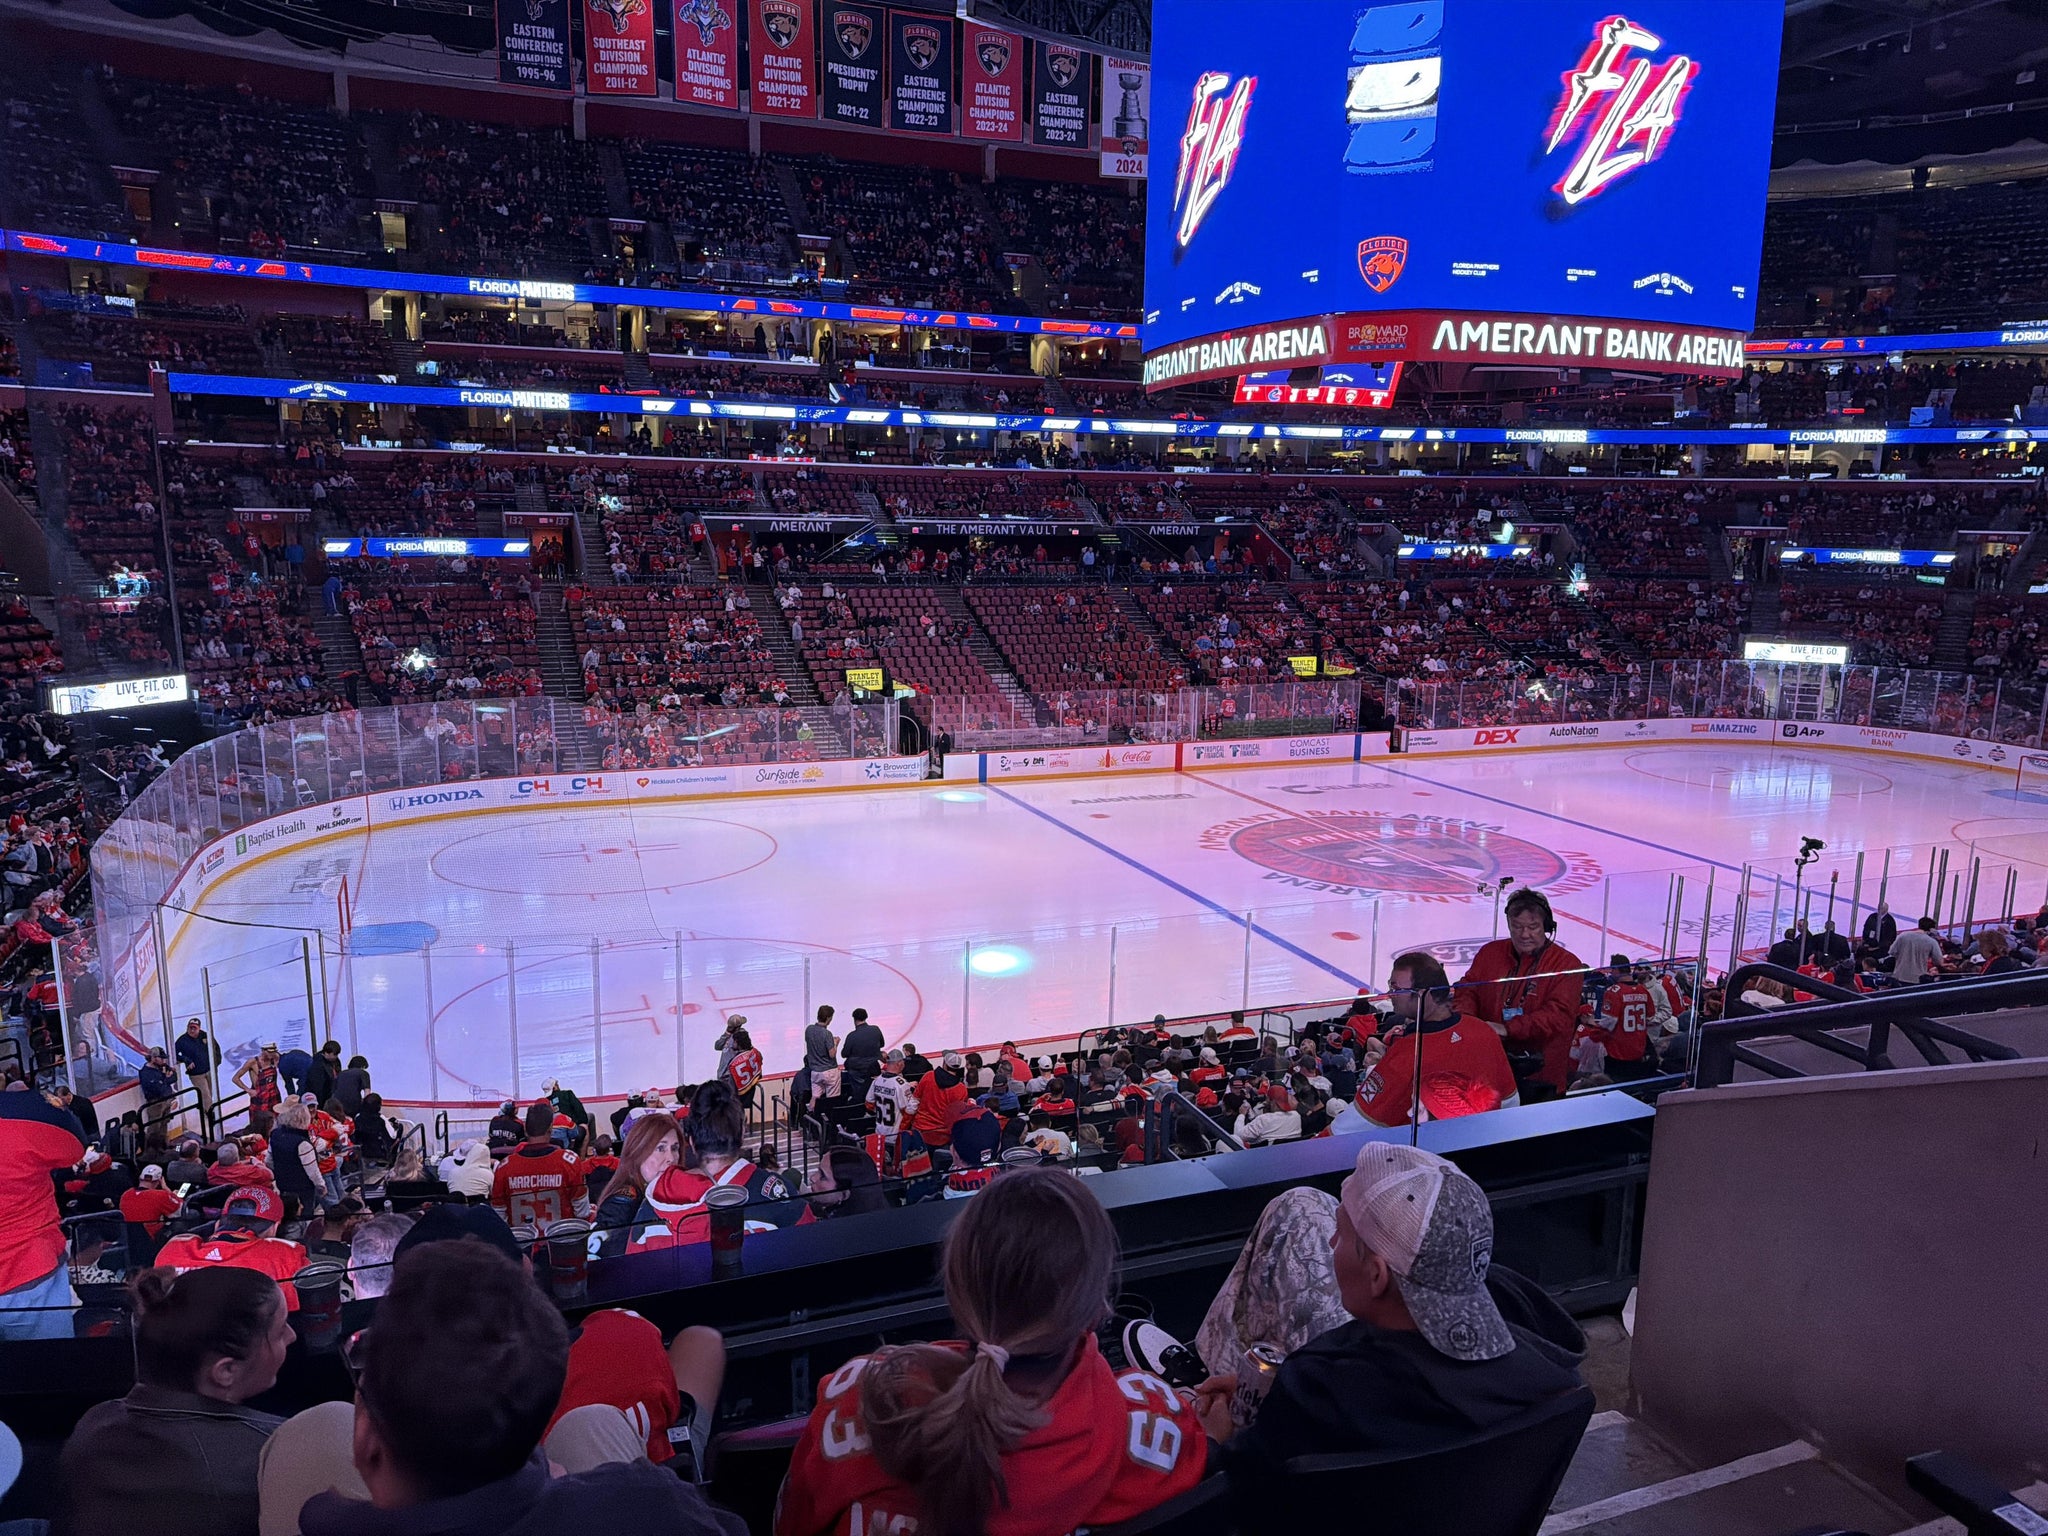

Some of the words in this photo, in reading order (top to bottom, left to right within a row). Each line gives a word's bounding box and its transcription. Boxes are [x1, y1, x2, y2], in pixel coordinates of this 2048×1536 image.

[837, 13, 869, 27] FLORIDA
[513, 23, 555, 39] EASTERN
[505, 36, 564, 55] CONFERENCE
[593, 37, 646, 51] SOUTHEAST
[600, 50, 641, 63] DIVISION
[686, 47, 726, 65] ATLANTIC
[763, 54, 802, 70] ATLANTIC
[516, 65, 556, 82] 1995-96
[593, 62, 648, 76] CHAMPIONS
[688, 60, 725, 77] DIVISION
[828, 58, 878, 77] PRESIDENTS'
[605, 76, 638, 89] 2011-12
[682, 71, 732, 90] CHAMPIONS
[764, 68, 802, 83] DIVISION
[904, 75, 939, 89] EASTERN
[758, 80, 808, 98] CHAMPIONS
[838, 76, 869, 93] TROPHY
[975, 82, 1011, 97] ATLANTIC
[692, 86, 725, 103] 2015-16
[896, 86, 947, 103] CONFERENCE
[1046, 92, 1079, 106] EASTERN
[766, 95, 801, 110] 2021-22
[897, 99, 945, 115] CHAMPIONS
[975, 95, 1010, 110] DIVISION
[837, 103, 869, 120] 2021-22
[969, 107, 1015, 122] CHAMPIONS
[1038, 103, 1085, 119] CONFERENCE
[1547, 17, 1690, 204] FLA
[905, 113, 938, 127] 2022-23
[976, 120, 1009, 134] 2023-24
[1039, 116, 1083, 131] CHAMPIONS
[1045, 129, 1077, 143] 2023-24
[1116, 159, 1143, 174] 2024
[1363, 240, 1403, 251] FLORIDA
[469, 279, 519, 294] FLORIDA
[519, 281, 575, 300] PANTHERS
[1633, 273, 1660, 289] FLORIDA
[1671, 275, 1694, 295] HOCKEY
[1433, 319, 1602, 357] AMERANT
[1606, 328, 1673, 361] BANK
[1675, 334, 1744, 368] ARENA
[1143, 345, 1198, 386] AMERANT
[1200, 336, 1248, 371] BANK
[1249, 325, 1325, 363] ARENA
[460, 391, 513, 404] FLORIDA
[512, 392, 570, 409] PANTHERS
[1506, 431, 1542, 442] FLORIDA
[1542, 430, 1587, 442] PANTHERS
[1790, 431, 1834, 442] FLORIDA
[1834, 430, 1887, 443] PANTHERS
[240, 512, 254, 521] 131
[509, 516, 523, 525] 132
[556, 517, 568, 525] 133
[770, 520, 832, 533] AMERANT
[937, 524, 957, 535] THE
[960, 525, 1016, 535] AMERANT
[1020, 525, 1058, 536] VAULT
[1150, 525, 1200, 536] AMERANT
[386, 542, 423, 551] FLORIDA
[423, 541, 466, 553] PANTHERS
[1831, 551, 1863, 559] FLORIDA
[1863, 551, 1900, 561] PANTHERS
[116, 681, 141, 695] LIVE.
[143, 680, 160, 692] FIT.
[162, 678, 178, 690] GO.
[1473, 728, 1520, 745] DEX
[1549, 726, 1599, 737] AutoNation
[1710, 724, 1757, 734] AMAZING
[1859, 728, 1909, 740] AMERANT
[1290, 738, 1330, 748] COMCAST
[1871, 738, 1894, 747] BANK
[1122, 750, 1152, 762] Coca-Cola
[1290, 747, 1330, 757] BUSINESS
[884, 763, 916, 771] Broward
[676, 776, 704, 784] Children's
[756, 768, 800, 783] Surfside
[518, 780, 549, 793] CH
[571, 777, 602, 790] CH
[407, 789, 484, 807] HONDA
[1071, 793, 1198, 805] AutoNation
[248, 828, 275, 847] Baptist
[277, 818, 306, 836] Health
[1198, 812, 1283, 850] AMERANT
[1401, 814, 1504, 831] ARENA
[1262, 872, 1383, 898] ARENA
[1623, 1003, 1647, 1032] 63
[509, 1174, 562, 1189] MARCHAND
[510, 1190, 561, 1231] 63
[1116, 1371, 1183, 1473] 63
